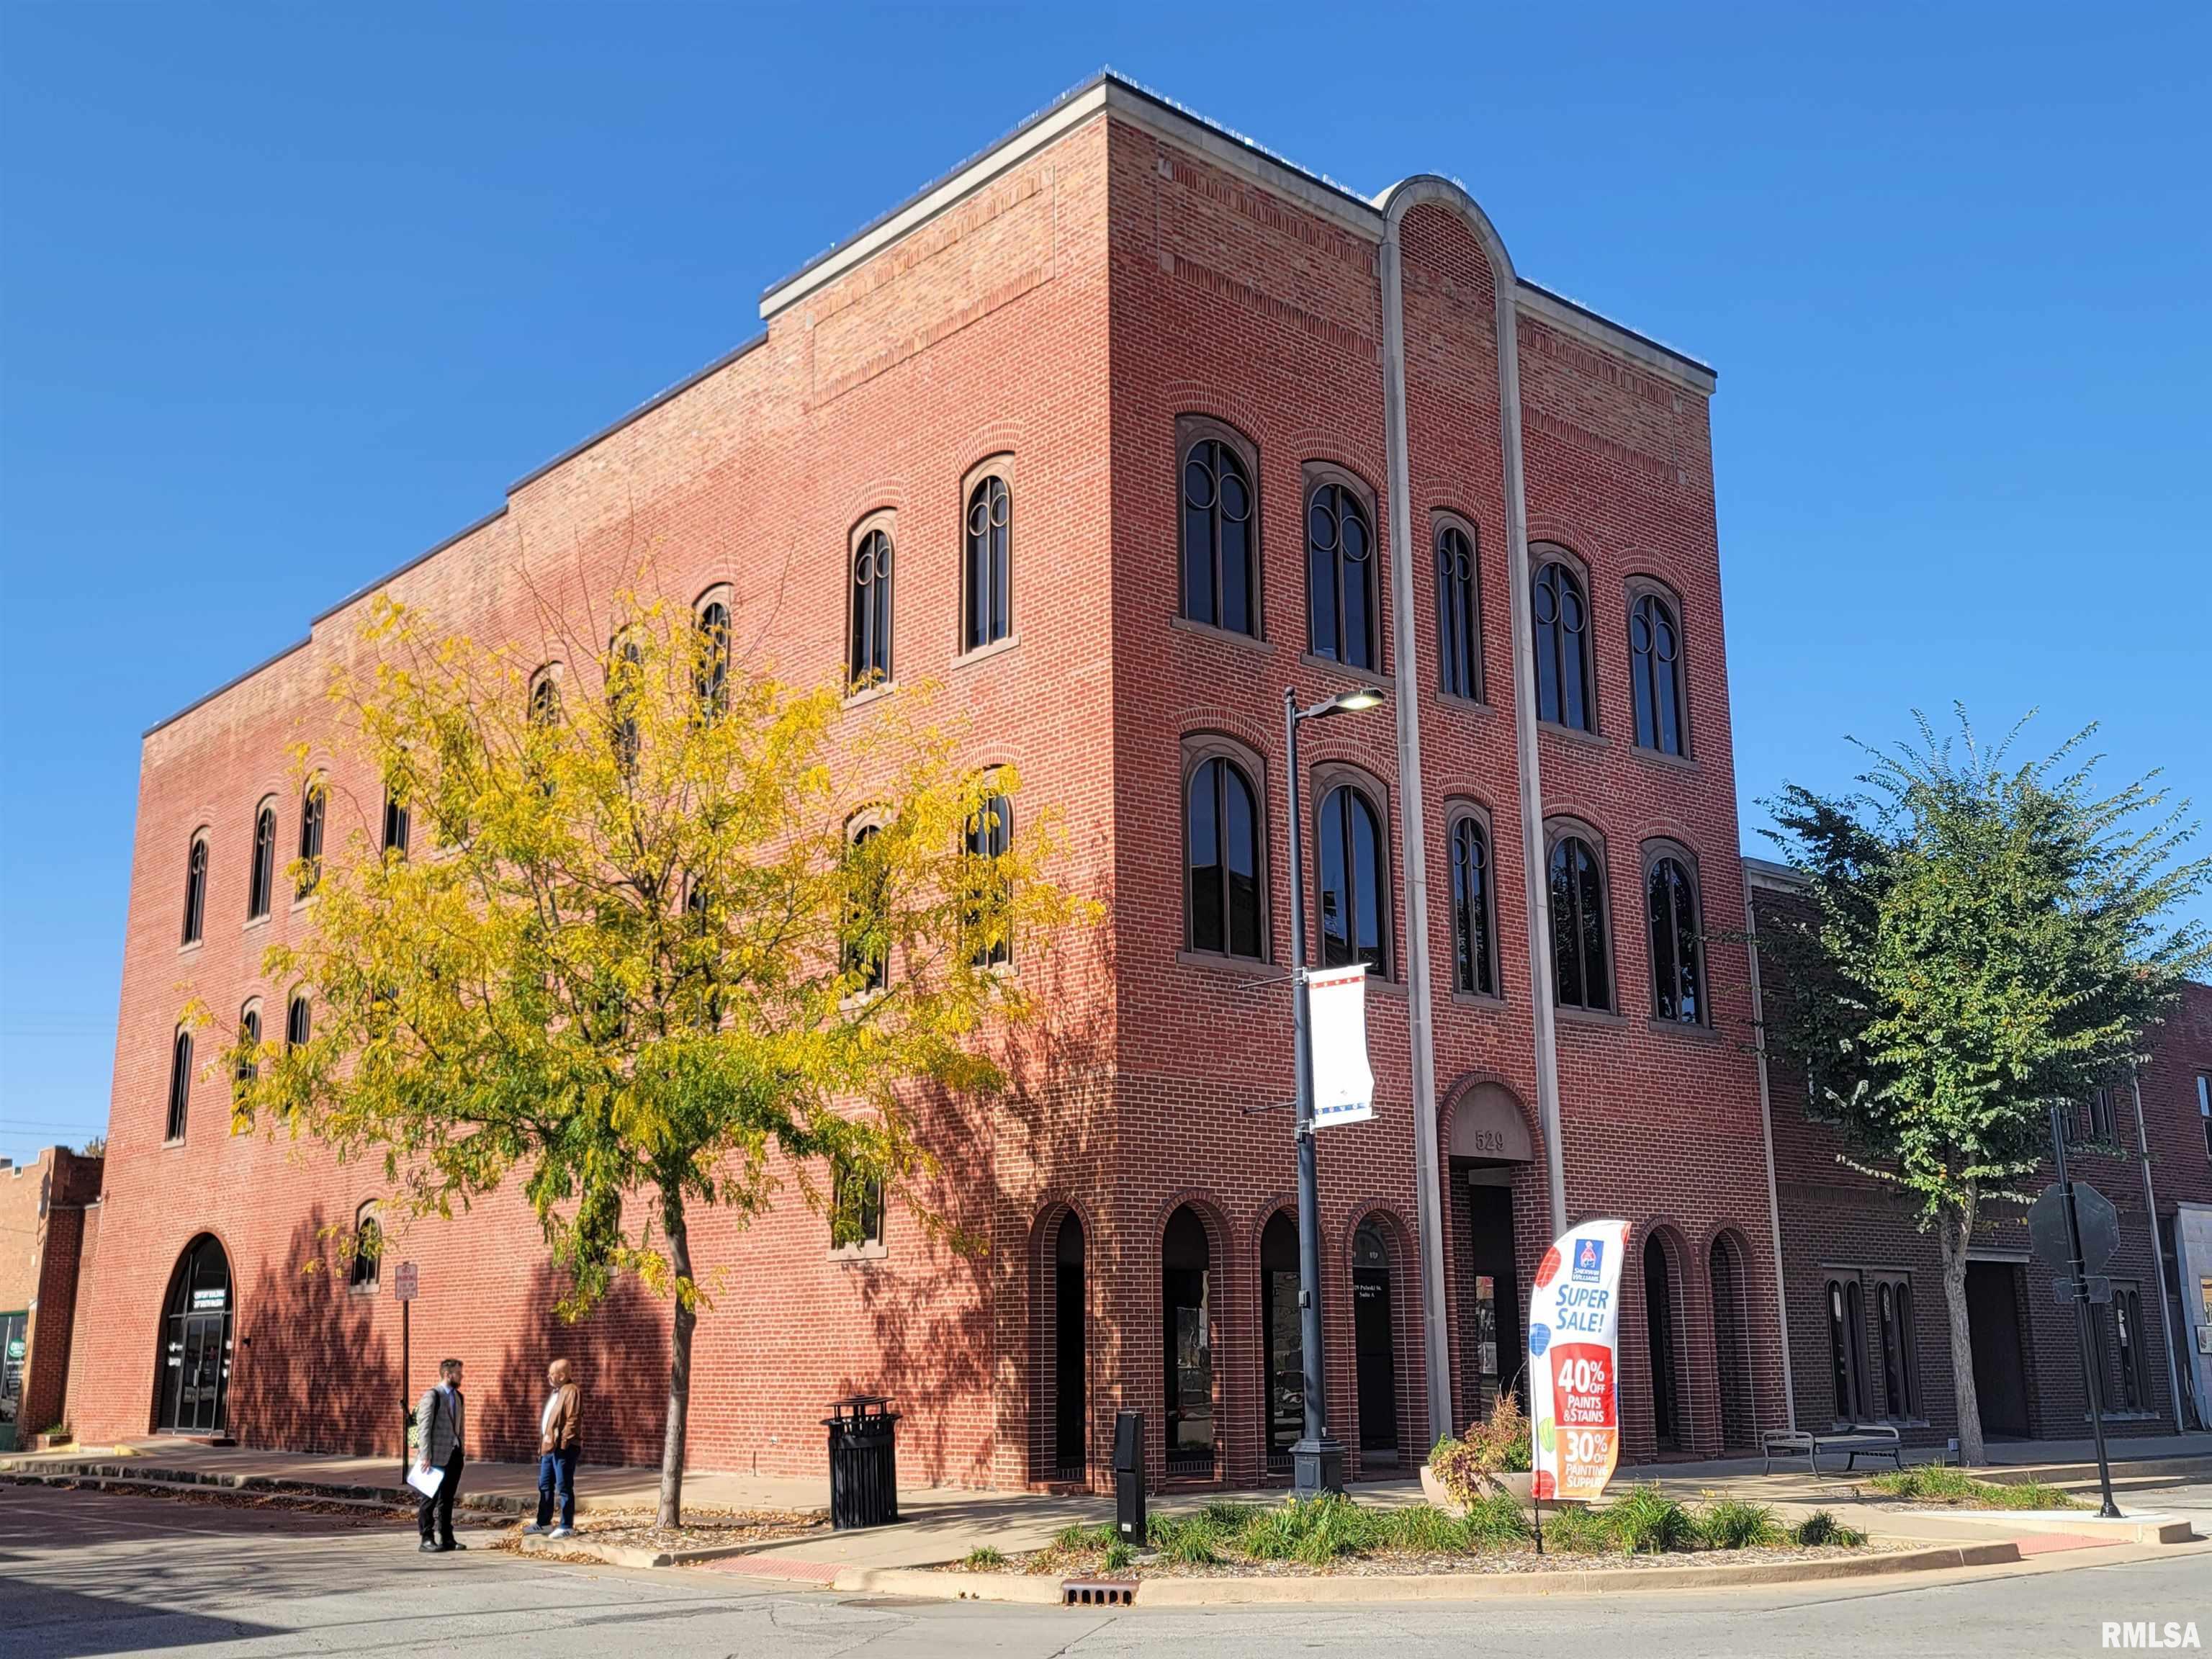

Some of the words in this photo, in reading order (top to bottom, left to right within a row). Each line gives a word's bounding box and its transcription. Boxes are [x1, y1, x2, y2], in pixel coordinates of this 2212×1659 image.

[1475, 1130, 1503, 1151] 529
[1555, 1284, 1609, 1309] SUPER
[1555, 1308, 1604, 1333] SALE!
[1589, 1382, 1606, 1394] OFF
[1568, 1394, 1601, 1409] PAINTS
[1565, 1462, 1609, 1475] PAINTING
